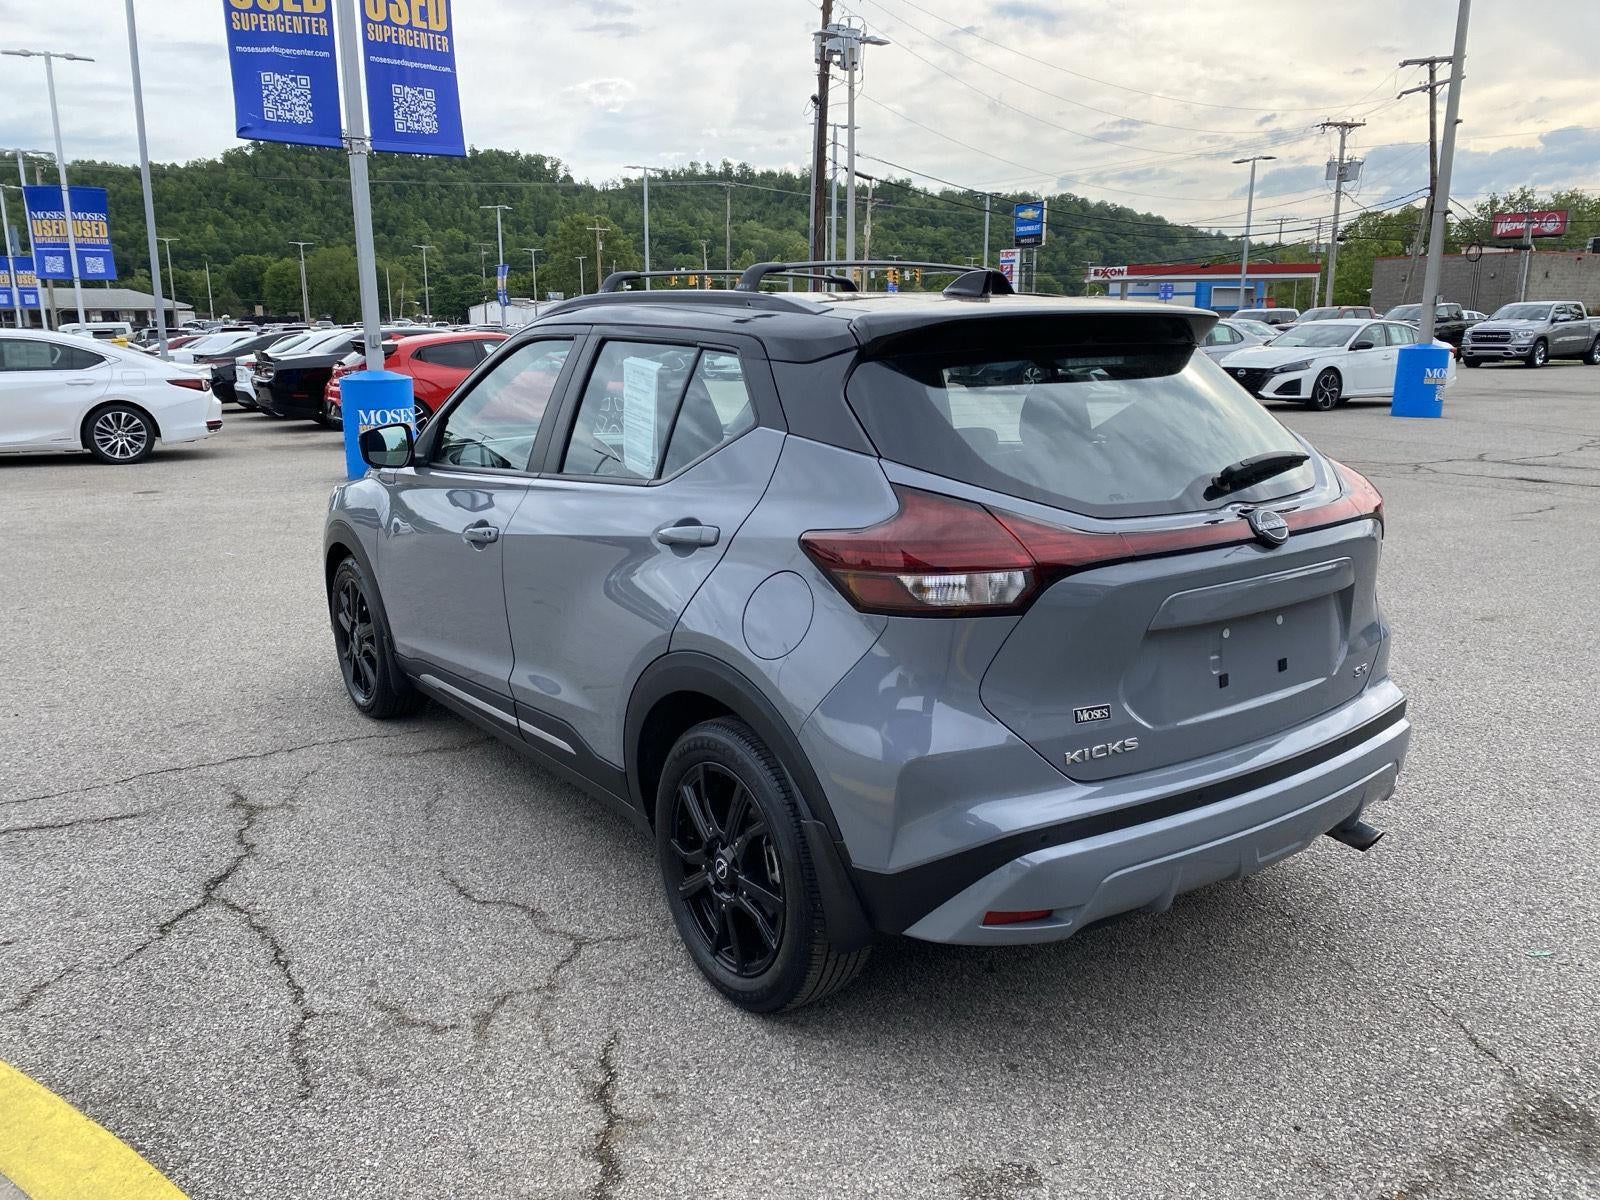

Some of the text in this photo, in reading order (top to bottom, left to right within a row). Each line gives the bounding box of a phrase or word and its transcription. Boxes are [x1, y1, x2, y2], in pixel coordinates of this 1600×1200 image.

[231, 11, 328, 36] SUPERCENTER
[366, 22, 449, 53] SUPERCENTER
[236, 46, 330, 57] mosesusedsupercenter.com
[31, 211, 66, 219] MOSES
[72, 212, 106, 220] MOSES
[32, 220, 68, 237] USED
[73, 221, 108, 237] USED
[1496, 217, 1539, 235] Wend's
[1093, 267, 1125, 279] EXXON
[358, 408, 414, 425] MOSES
[1076, 707, 1109, 722] MOSES
[1064, 737, 1139, 765] KICKS
